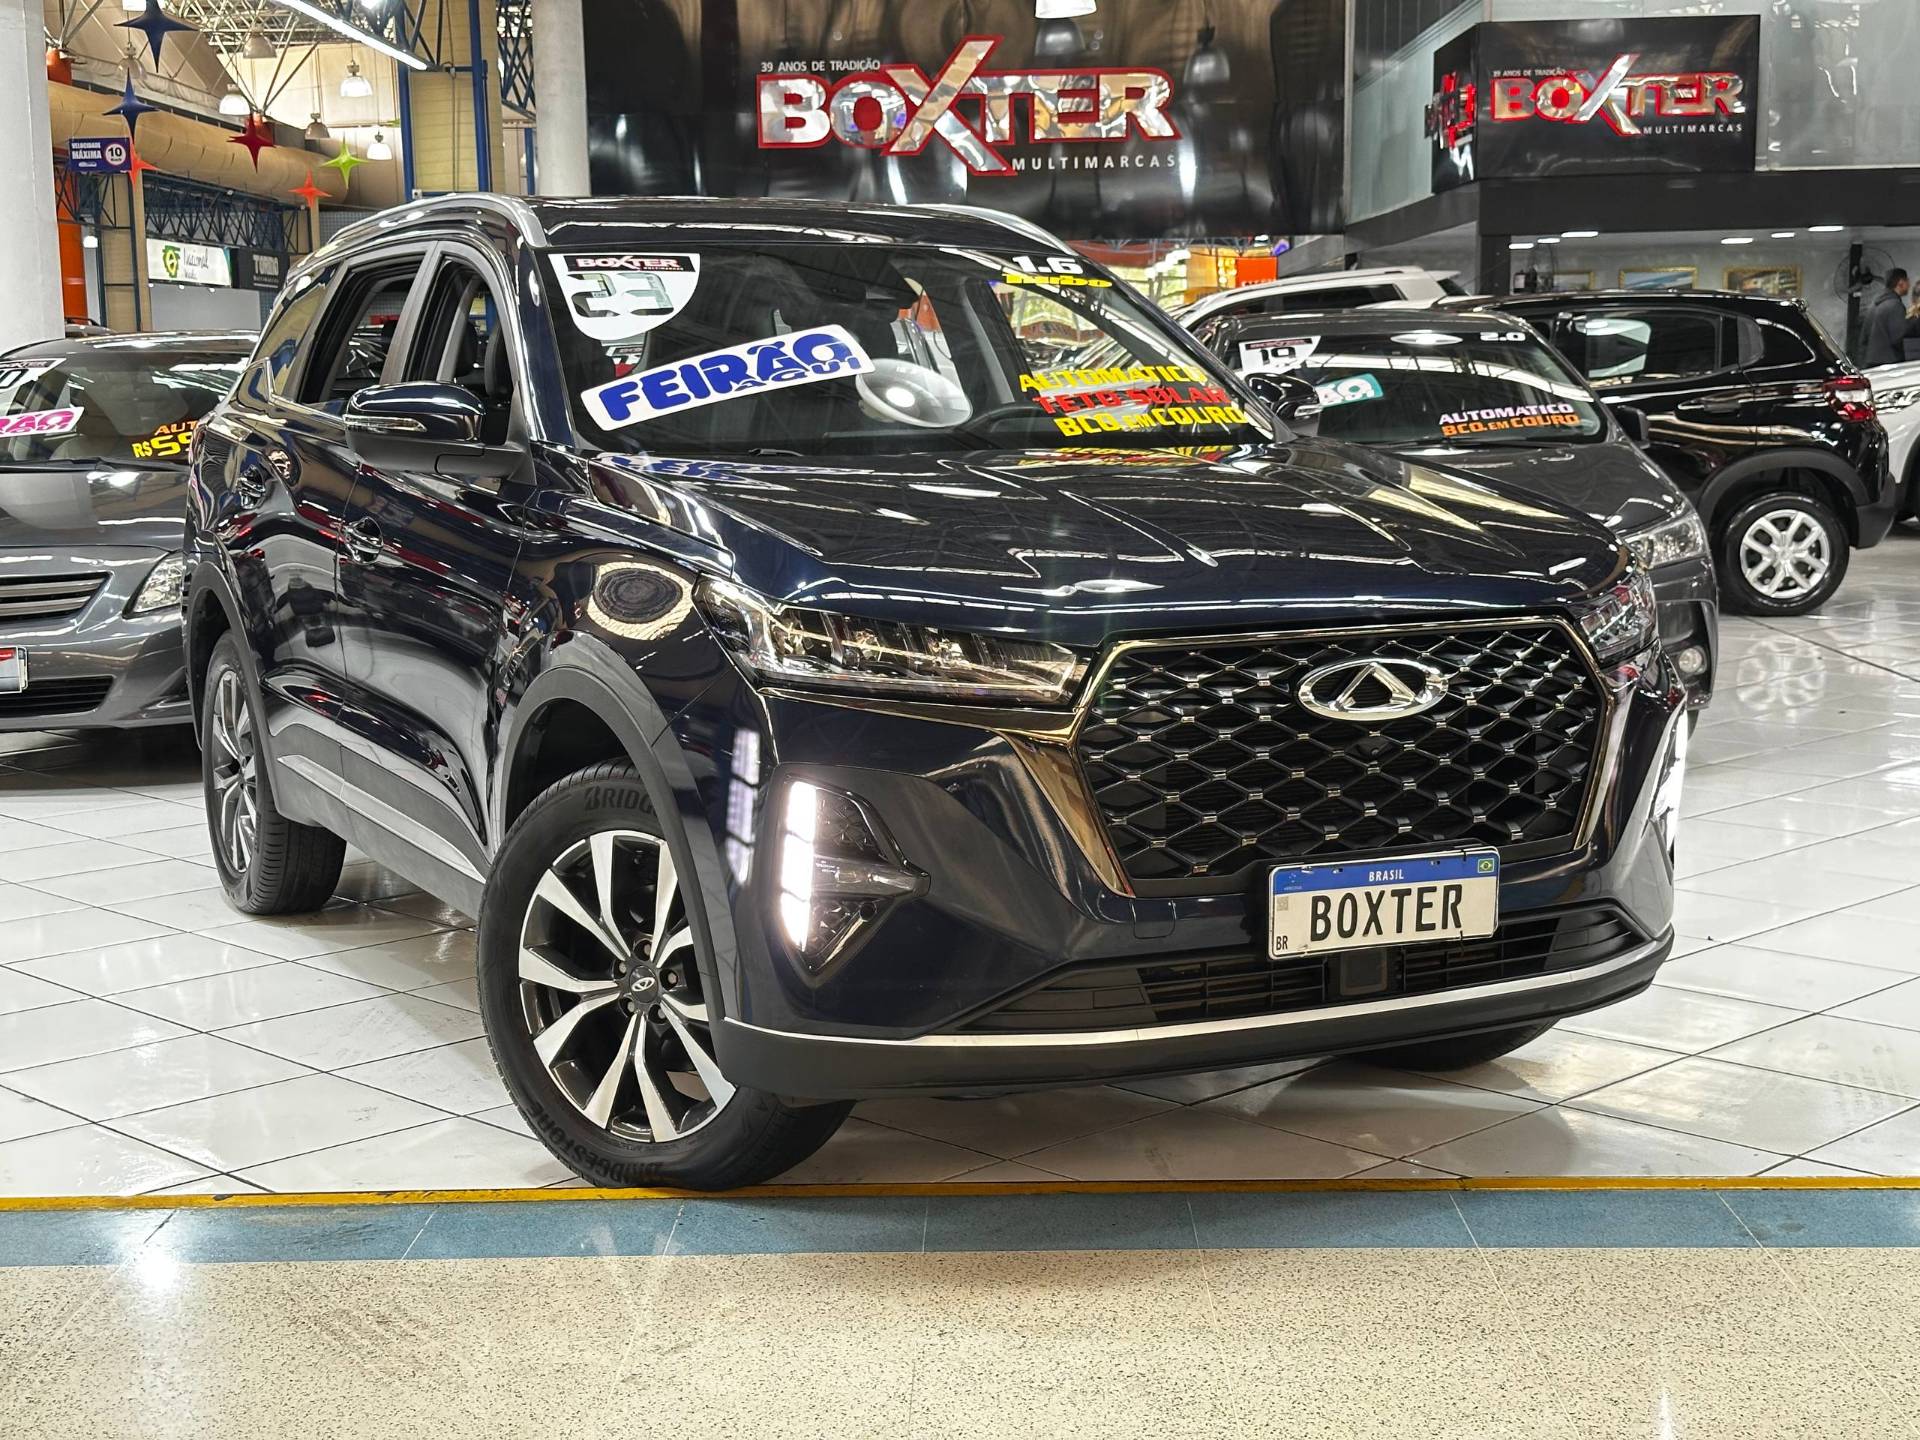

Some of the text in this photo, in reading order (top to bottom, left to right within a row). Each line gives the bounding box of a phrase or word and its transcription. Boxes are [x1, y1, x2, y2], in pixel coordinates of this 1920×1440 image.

[760, 57, 881, 74] 39 ANOS DE TRADIÇÃO
[1491, 52, 1747, 137] BOXTER
[756, 35, 1182, 177] BOXTER
[1643, 123, 1744, 136] MULTIMARCAS
[72, 149, 102, 160] MÁXIMA
[107, 147, 123, 157] 10
[1012, 155, 1177, 171] MULTIMARCAS
[576, 256, 680, 270] BOXTER
[1012, 255, 1083, 275] 1.6
[1480, 331, 1526, 342] 2.0
[599, 333, 854, 421] FEIRÃO
[733, 356, 861, 392] AQUI
[1034, 385, 1232, 415] TETO SOLAR
[1152, 406, 1250, 428] COURO
[1488, 419, 1510, 431] EM
[1510, 413, 1580, 429] COURO
[584, 785, 658, 816] BRIDG
[1368, 869, 1405, 882] BRASIL
[1310, 884, 1463, 942] BOXTER
[1276, 935, 1289, 951] BR
